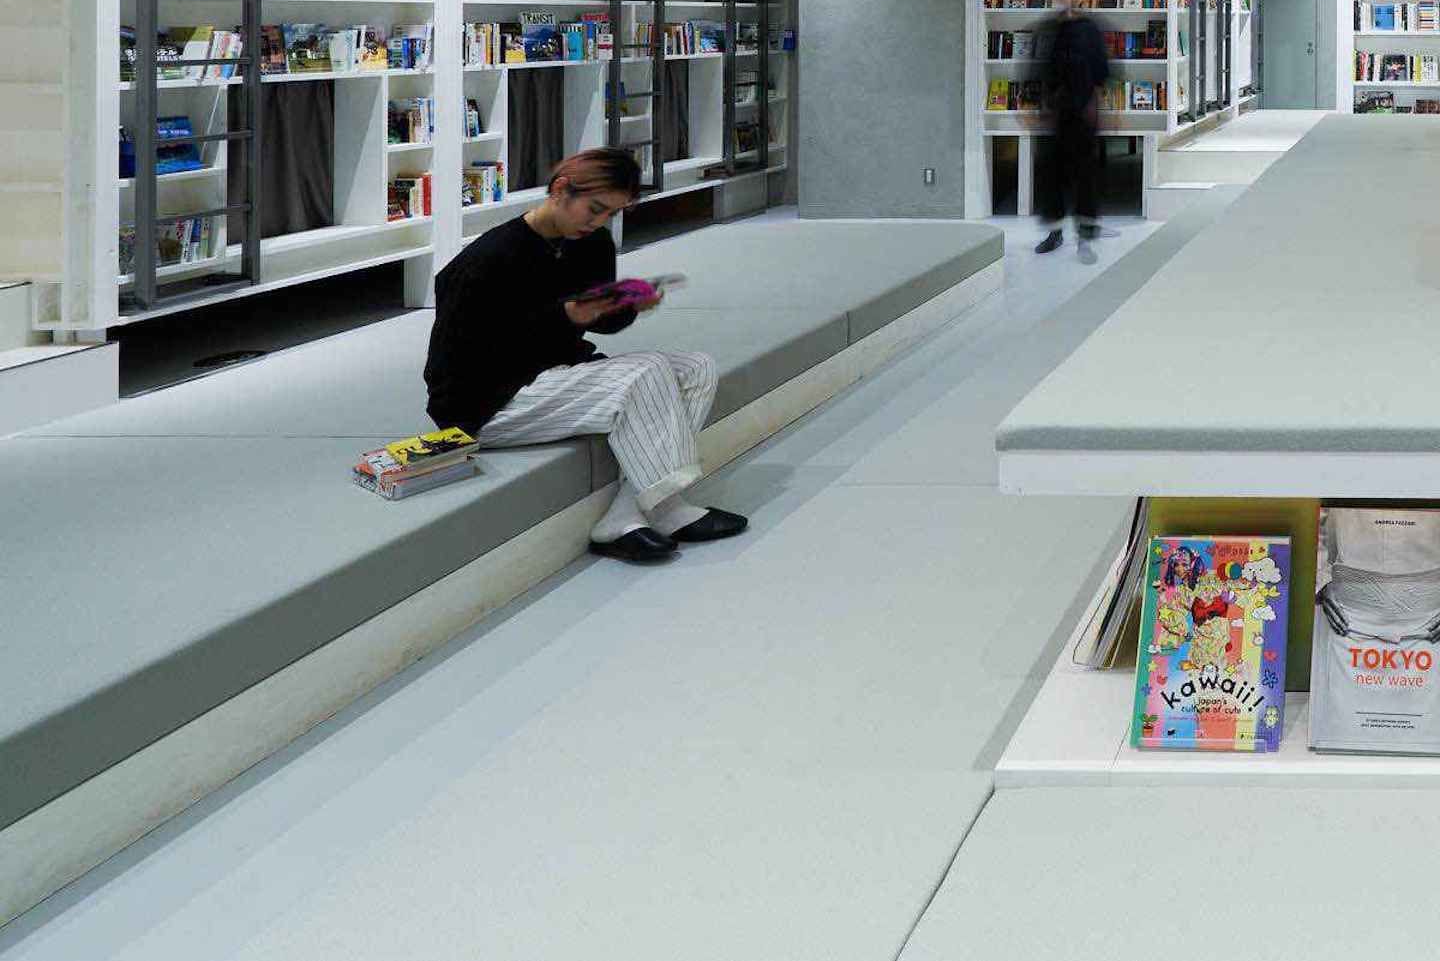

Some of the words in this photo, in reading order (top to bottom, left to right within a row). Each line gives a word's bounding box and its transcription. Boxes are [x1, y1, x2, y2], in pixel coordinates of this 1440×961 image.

[1349, 648, 1433, 671] TOKYO
[1161, 672, 1265, 712] kawaii!
[1356, 674, 1384, 686] new
[1388, 675, 1425, 688] wave
